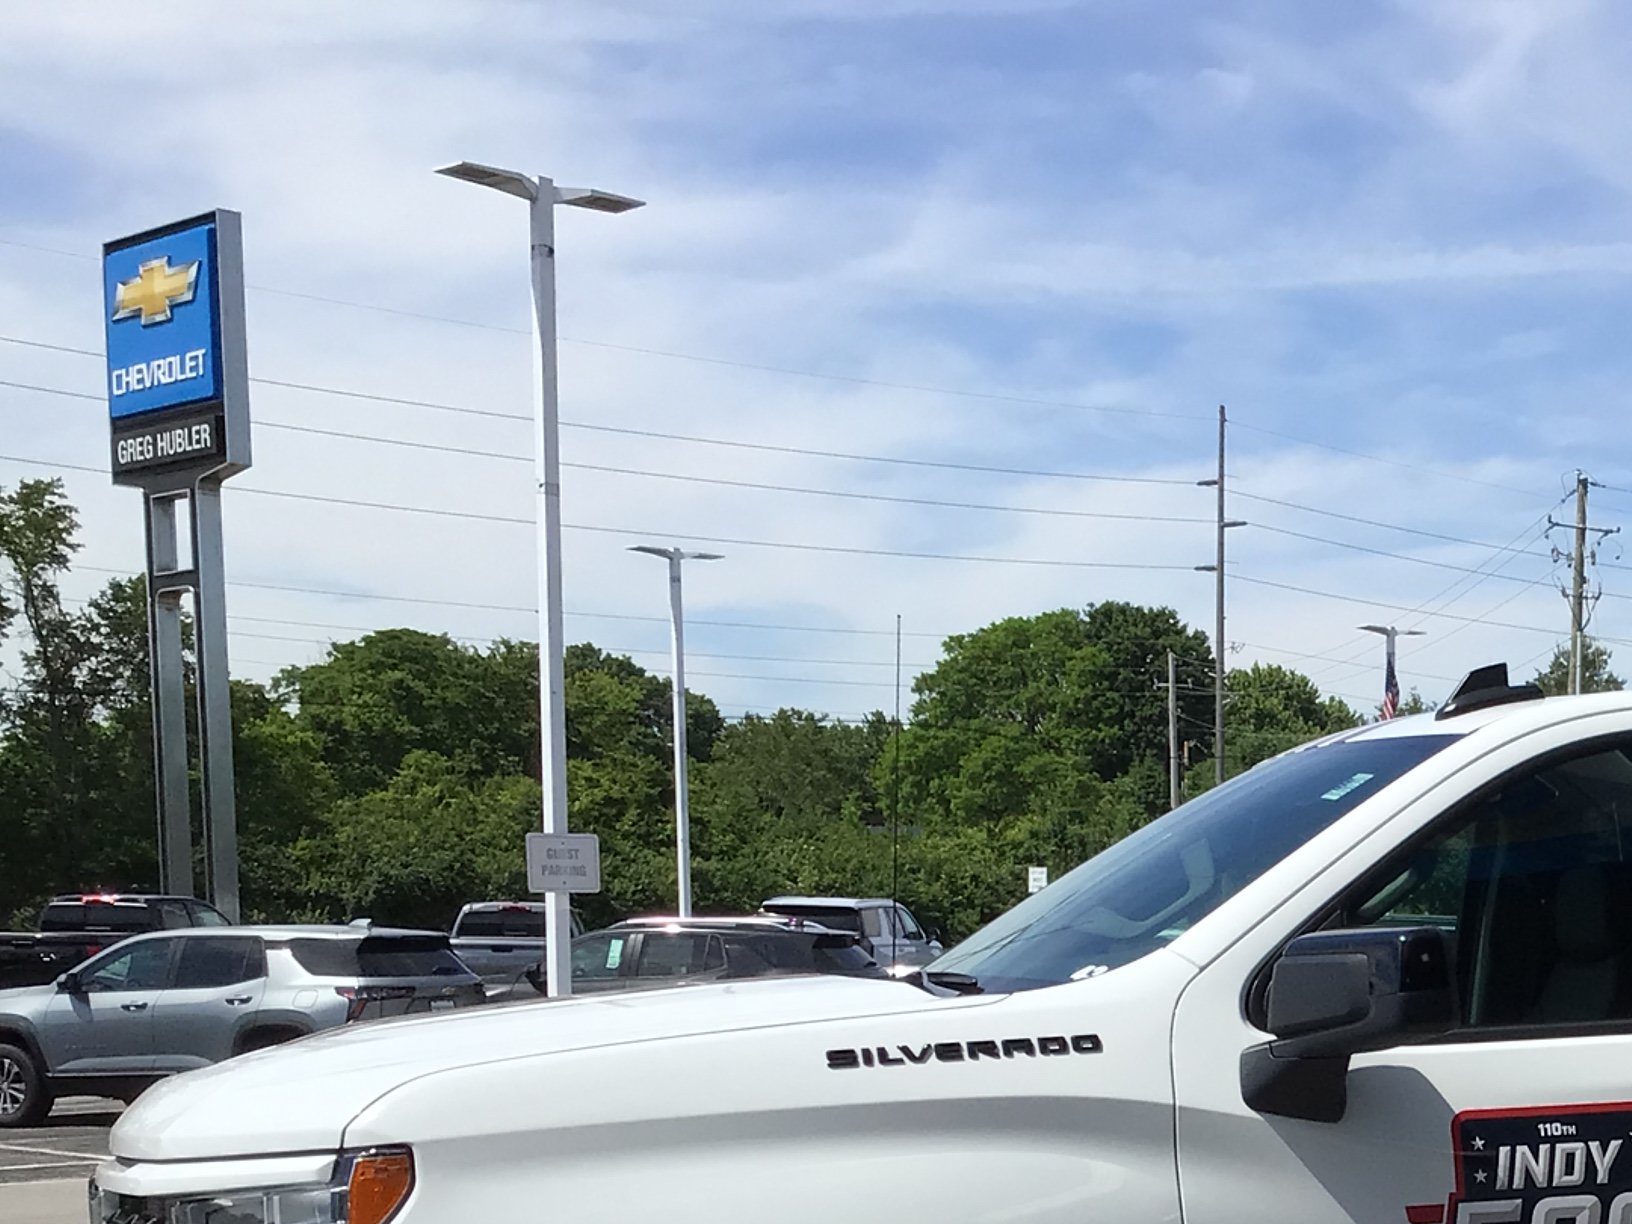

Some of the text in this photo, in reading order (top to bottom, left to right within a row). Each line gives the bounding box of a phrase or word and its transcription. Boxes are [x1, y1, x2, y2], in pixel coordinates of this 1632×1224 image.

[112, 348, 206, 395] CHEVROLET
[117, 423, 211, 464] GREG HUBLER
[826, 1034, 1103, 1070] SILVERADO
[1537, 1122, 1577, 1137] 110TH
[1495, 1139, 1623, 1190] INDY
